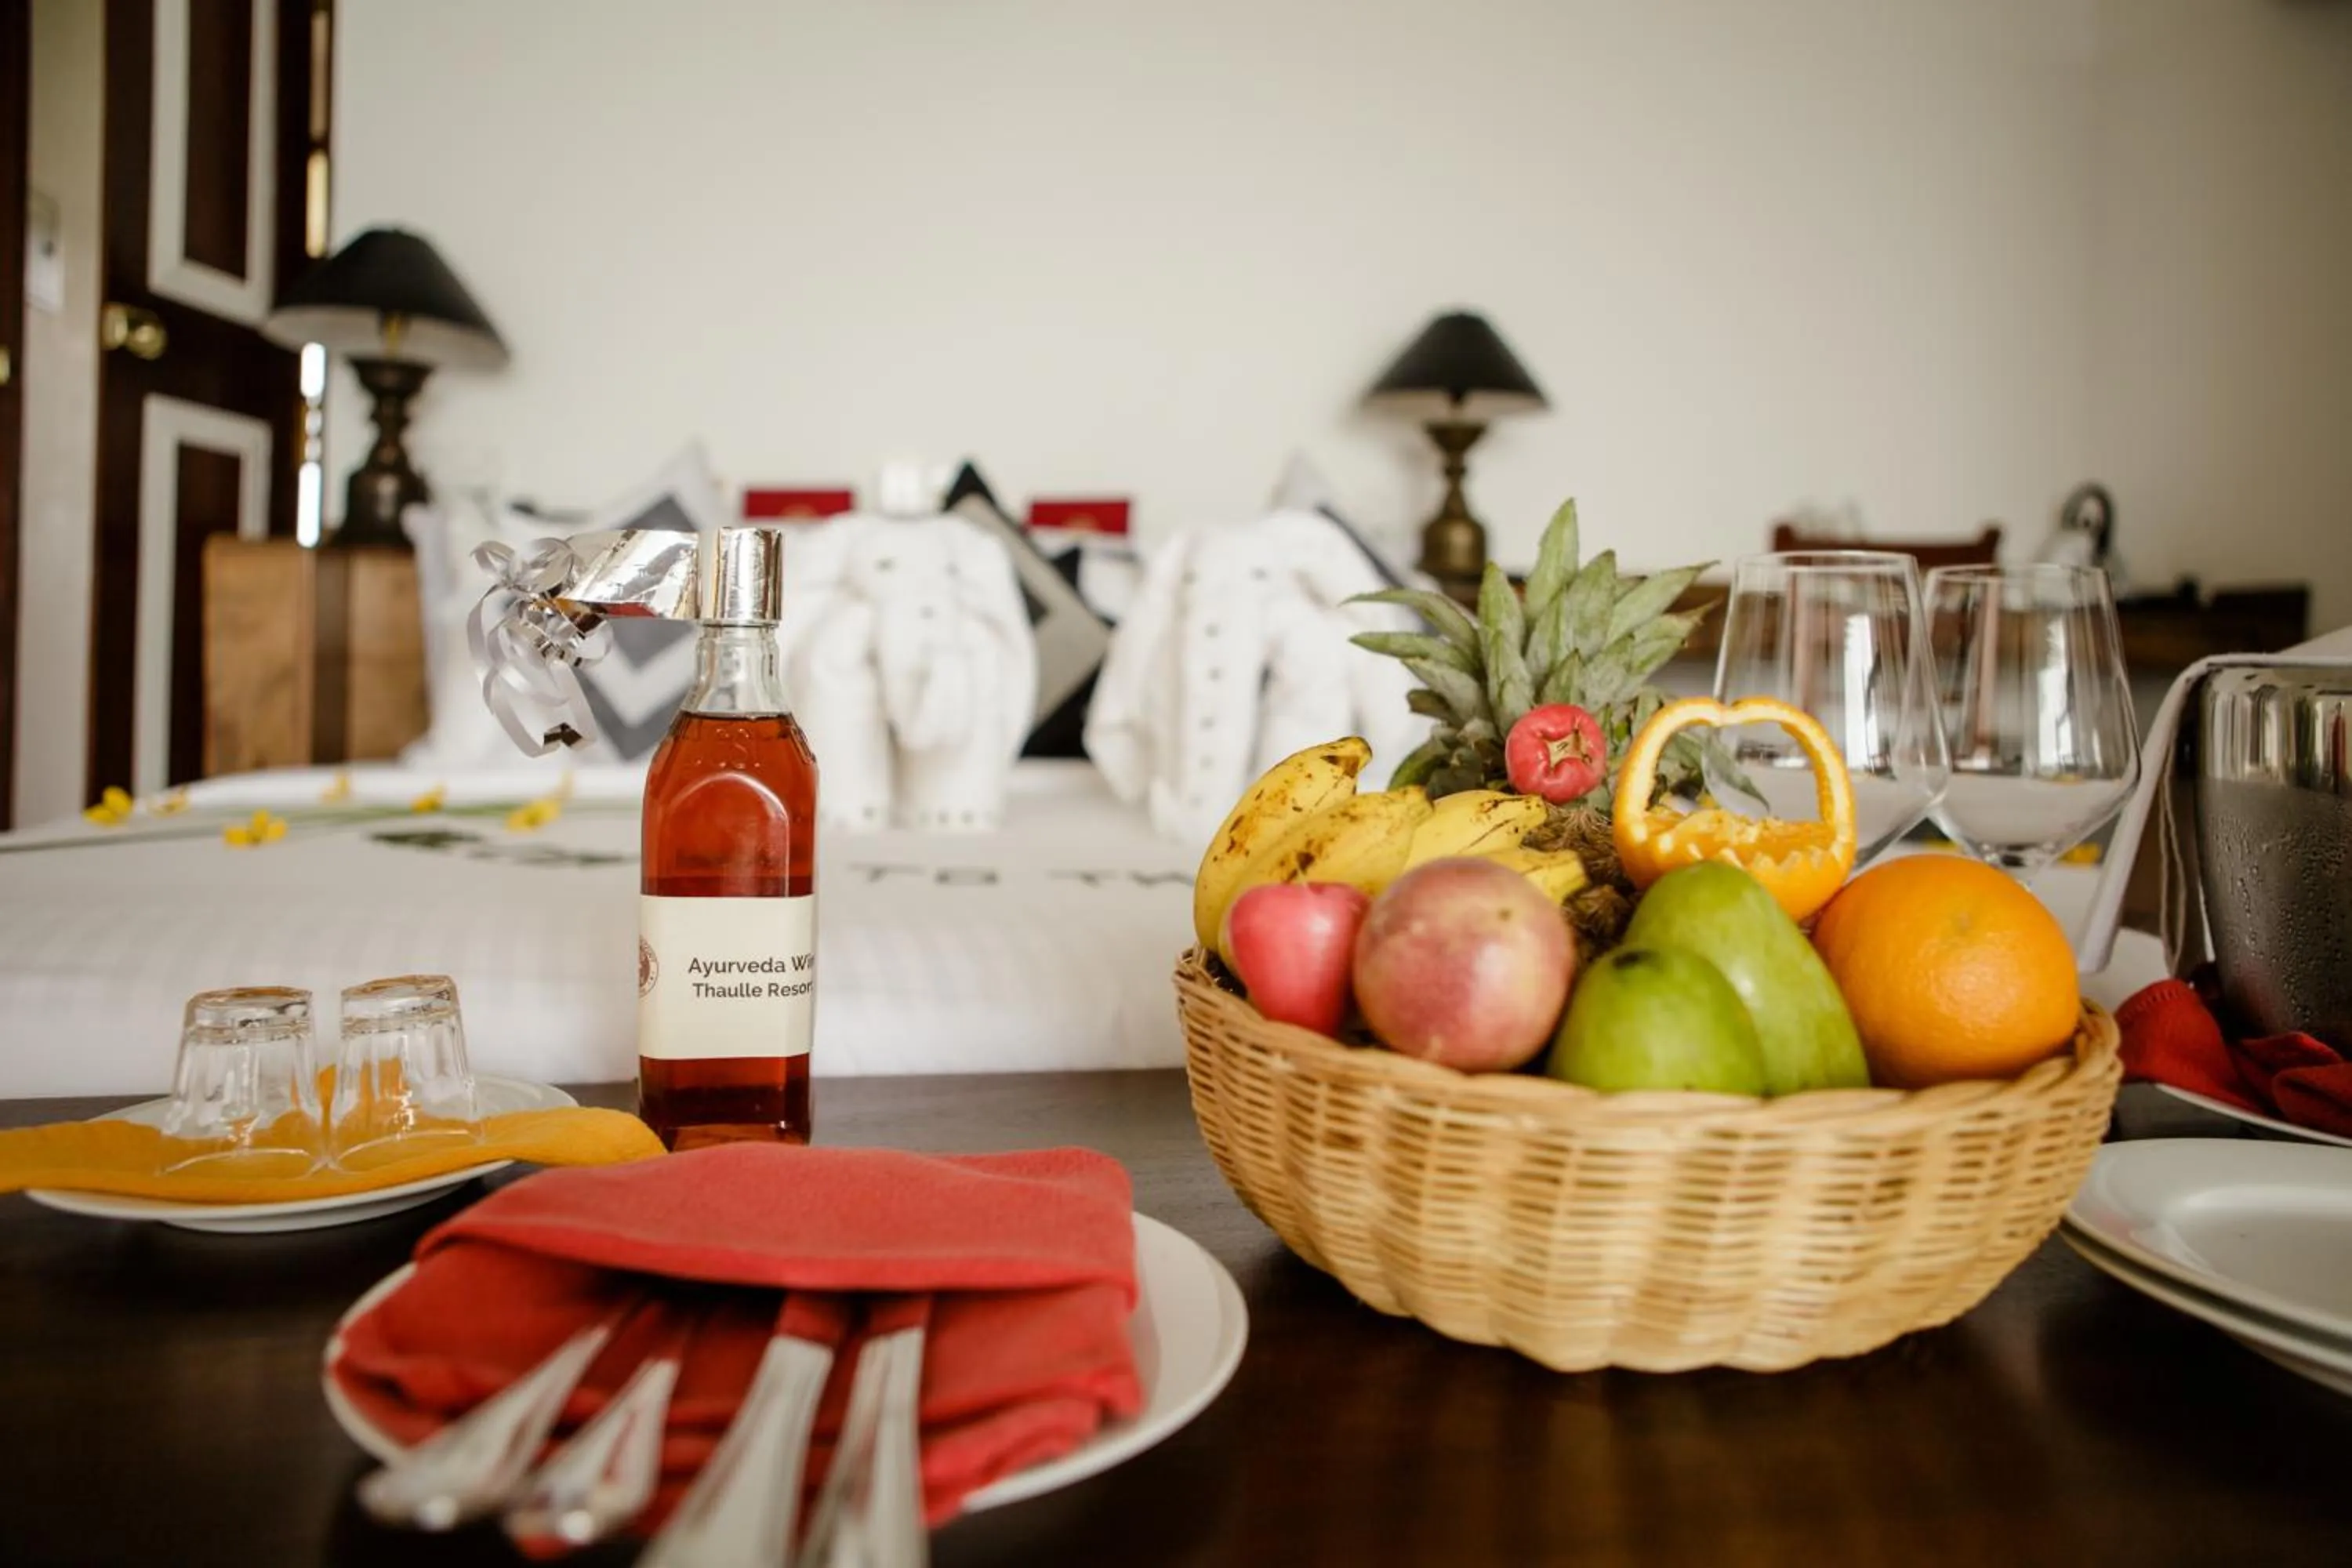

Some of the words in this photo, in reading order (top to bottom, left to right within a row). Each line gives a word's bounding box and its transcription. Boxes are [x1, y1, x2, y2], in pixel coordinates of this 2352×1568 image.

[689, 956, 786, 977] Ayurveda
[693, 982, 763, 998] Thaulle
[768, 982, 812, 997] Resor
